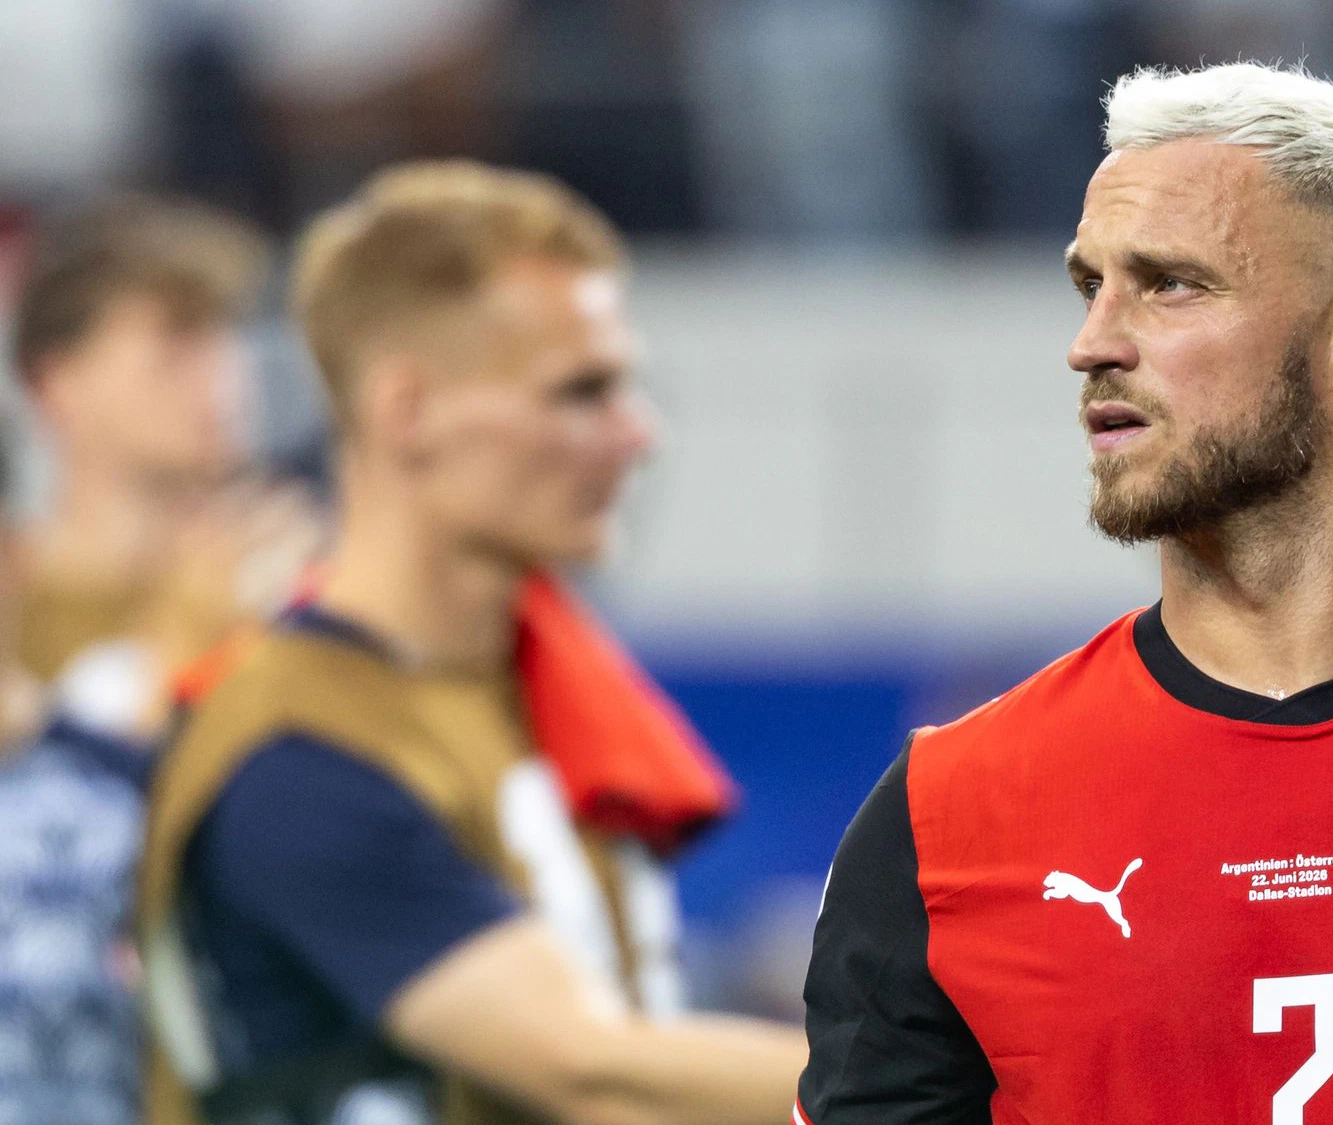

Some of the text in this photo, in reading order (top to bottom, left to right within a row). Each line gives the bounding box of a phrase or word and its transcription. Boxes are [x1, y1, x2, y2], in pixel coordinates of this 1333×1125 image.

[1221, 859, 1288, 875] Argentinien
[1251, 869, 1328, 886] 22. Juni 2026
[1248, 884, 1333, 901] Dallas-Stadion
